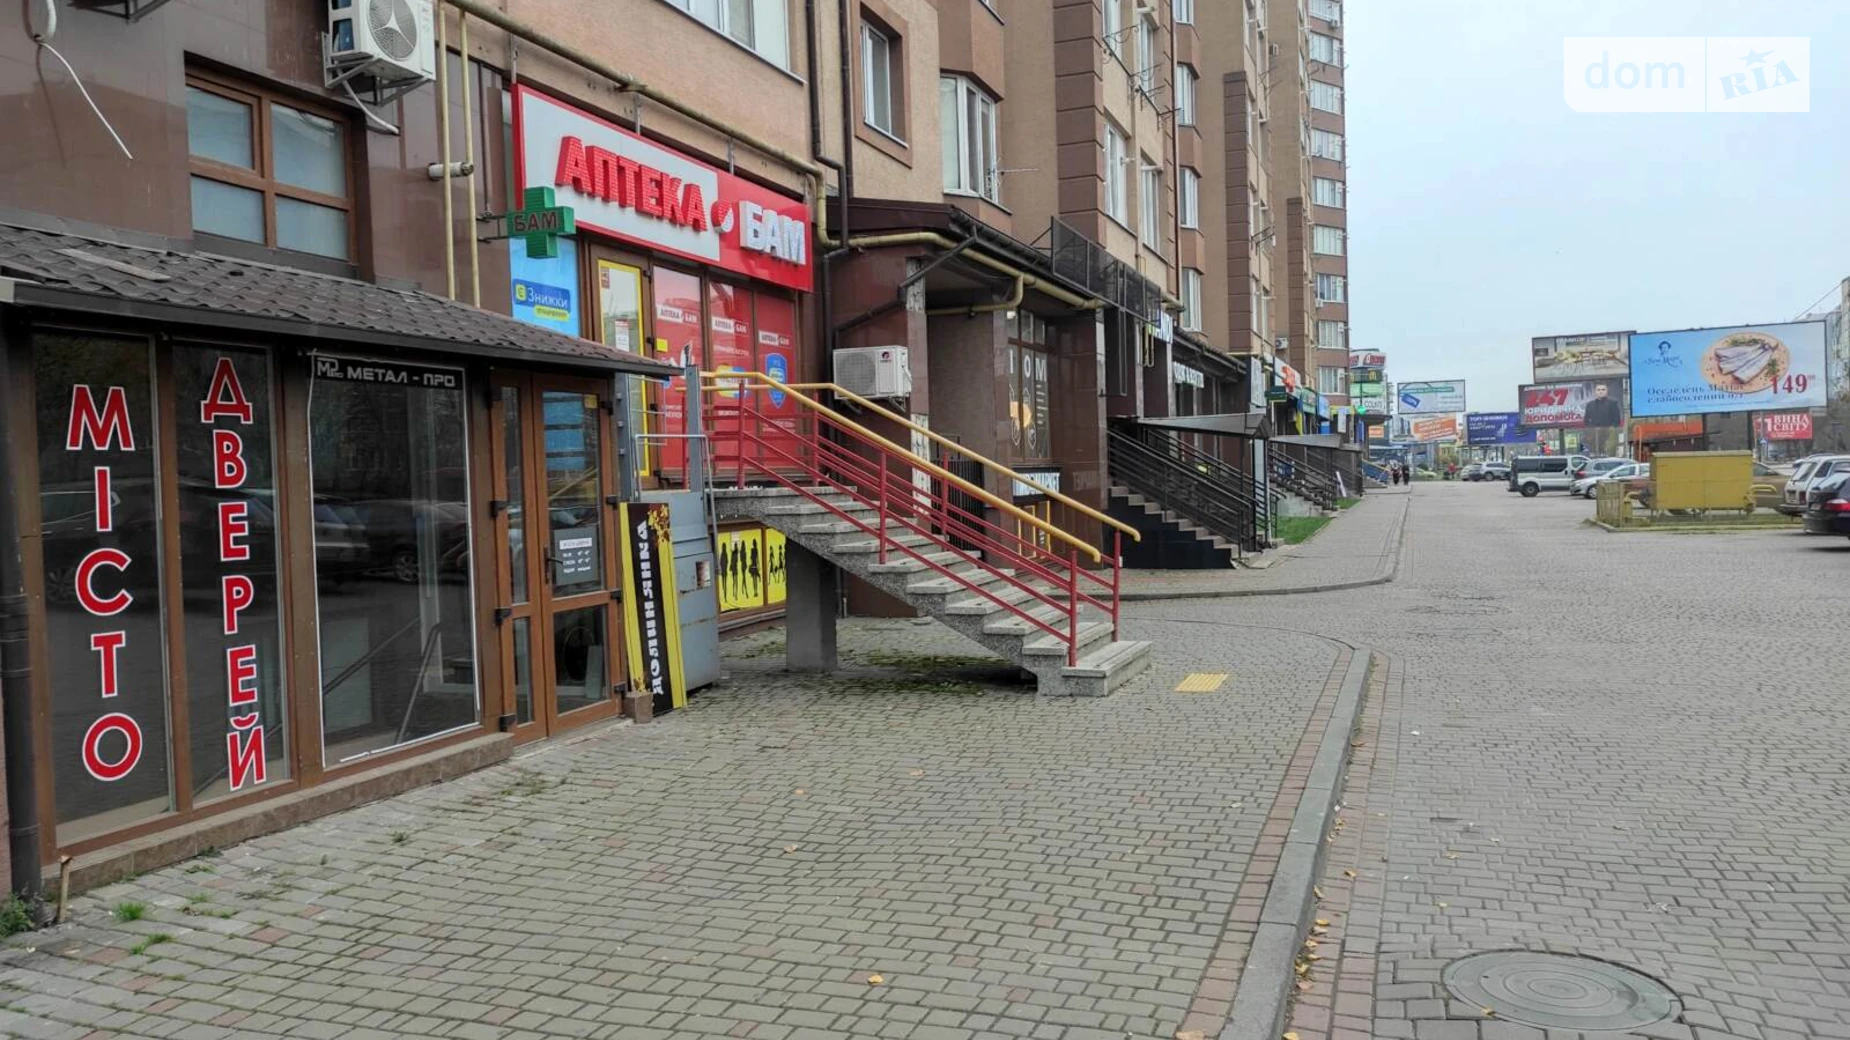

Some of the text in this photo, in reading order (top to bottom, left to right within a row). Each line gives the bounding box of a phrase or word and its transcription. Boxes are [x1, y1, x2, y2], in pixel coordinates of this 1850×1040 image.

[554, 135, 806, 265] АПТЕКА БАМ
[514, 210, 558, 232] БАМ
[346, 366, 408, 384] МЕТАЛ
[423, 373, 456, 388] ПРО
[1770, 373, 1808, 395] 149
[1525, 412, 1584, 423] ДОПОМОГА
[1774, 413, 1809, 423] ВИНА
[1774, 422, 1809, 431] СВІТУ
[65, 383, 144, 782] МІСТО
[200, 357, 267, 792] ДВЕРЕЙ
